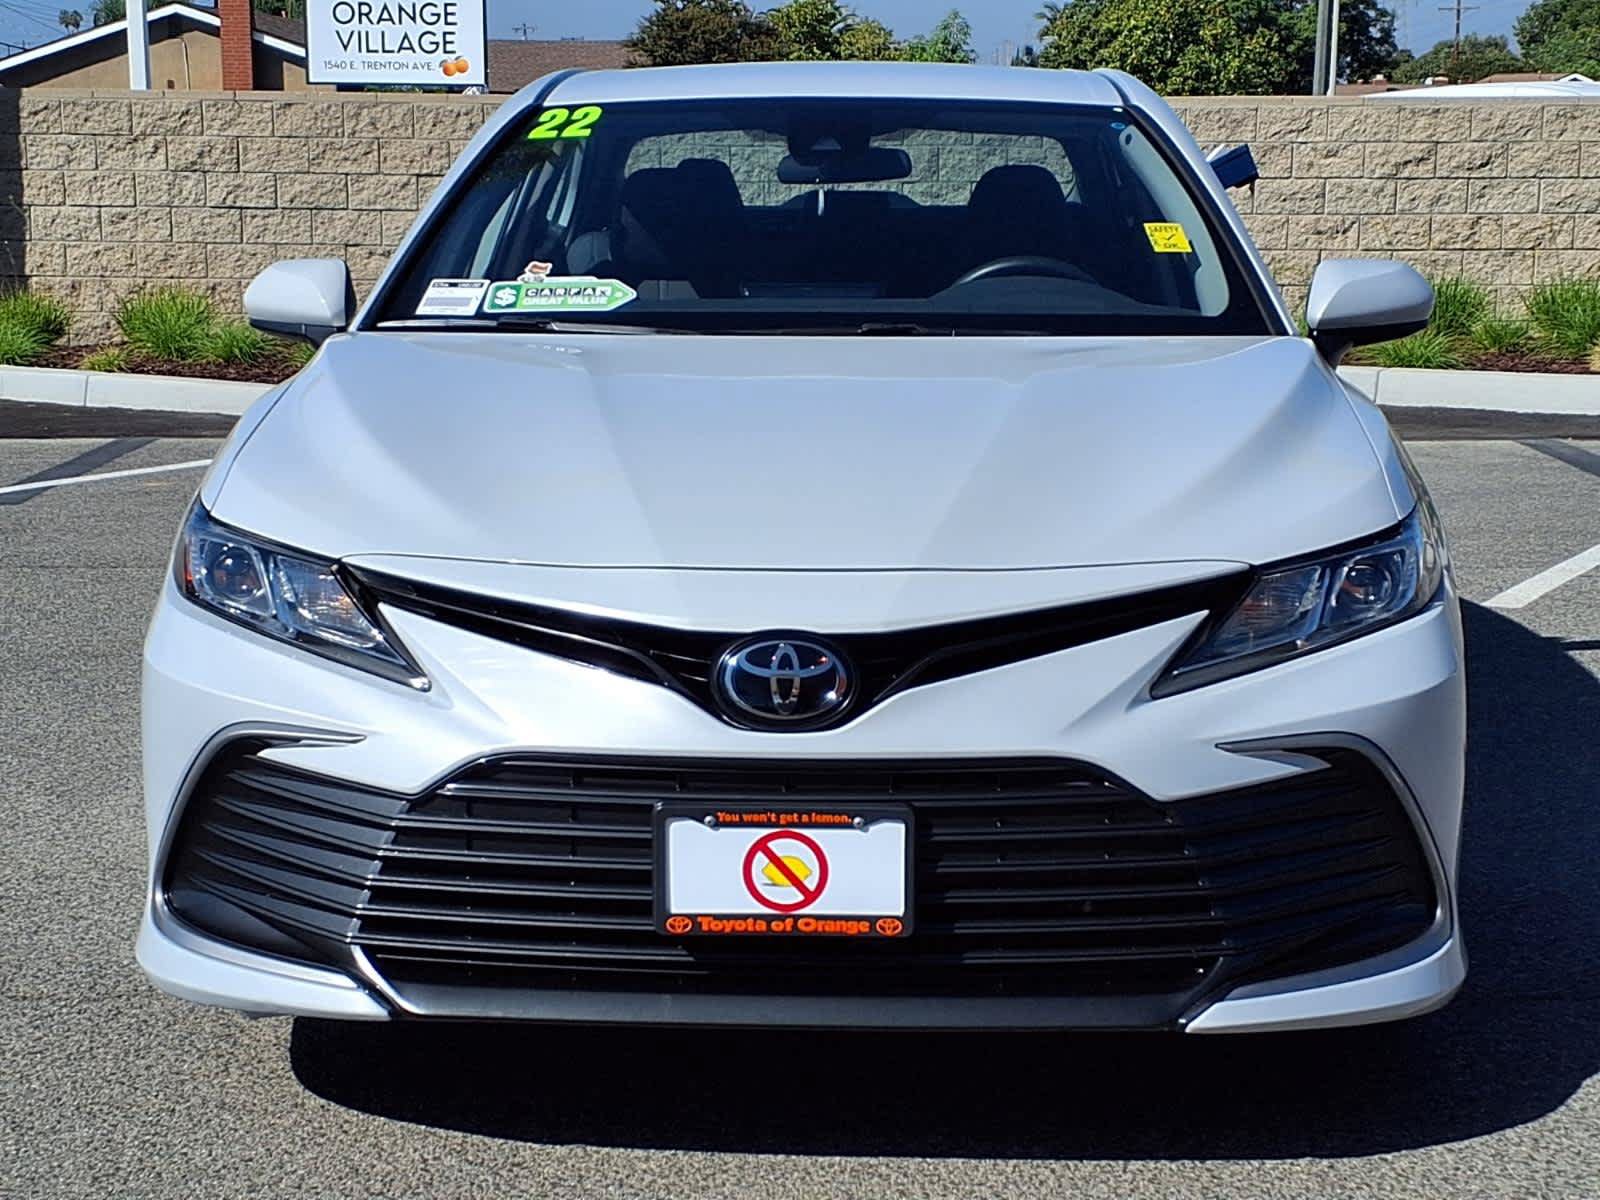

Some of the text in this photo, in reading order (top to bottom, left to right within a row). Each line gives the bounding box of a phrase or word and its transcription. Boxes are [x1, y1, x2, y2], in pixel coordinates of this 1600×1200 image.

[332, 1, 458, 25] ORANGE
[335, 30, 457, 54] VILLAGE
[323, 60, 348, 70] 1540
[362, 60, 409, 71] TRENTON
[412, 61, 436, 71] AVE.
[527, 105, 602, 139] 22
[522, 296, 609, 305] GREAT VALUE
[717, 812, 852, 825] You won't get a lemon.
[697, 916, 870, 934] Toyota of Orange
